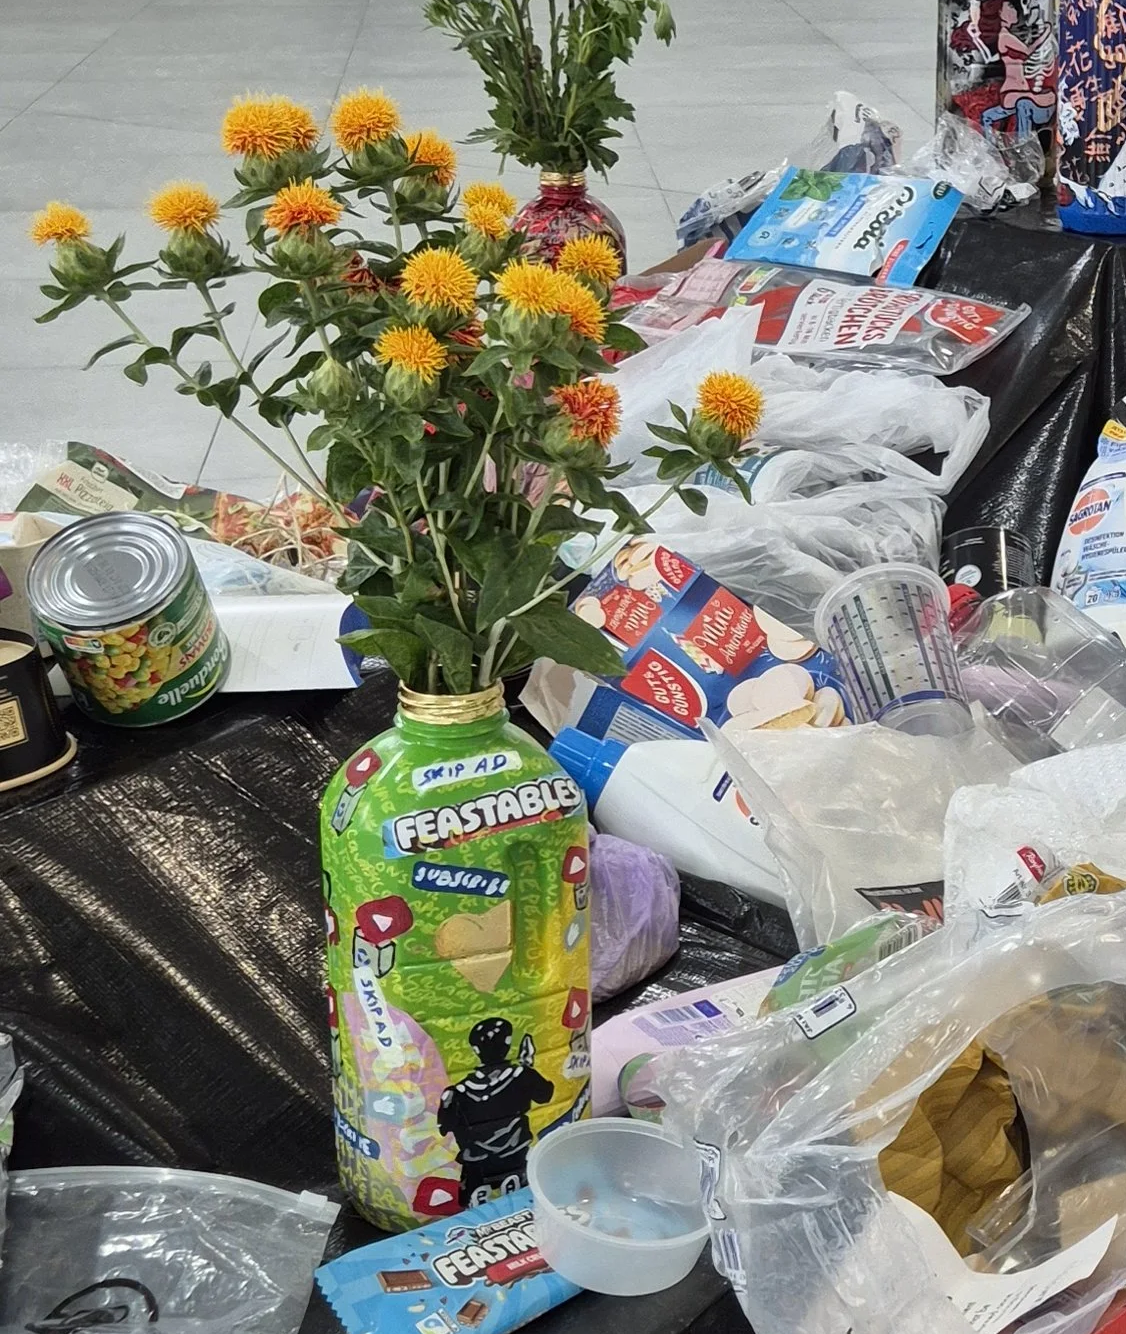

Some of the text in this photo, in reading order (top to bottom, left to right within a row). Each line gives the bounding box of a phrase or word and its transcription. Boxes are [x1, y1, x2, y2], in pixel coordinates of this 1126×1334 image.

[1068, 500, 1112, 527] SAGROTAN
[692, 603, 735, 650] Mini
[650, 660, 690, 717] GÜNSTIG
[418, 753, 508, 787] SKIP AD
[393, 776, 582, 852] FEASTABLES
[359, 977, 393, 1049] SKIP AD
